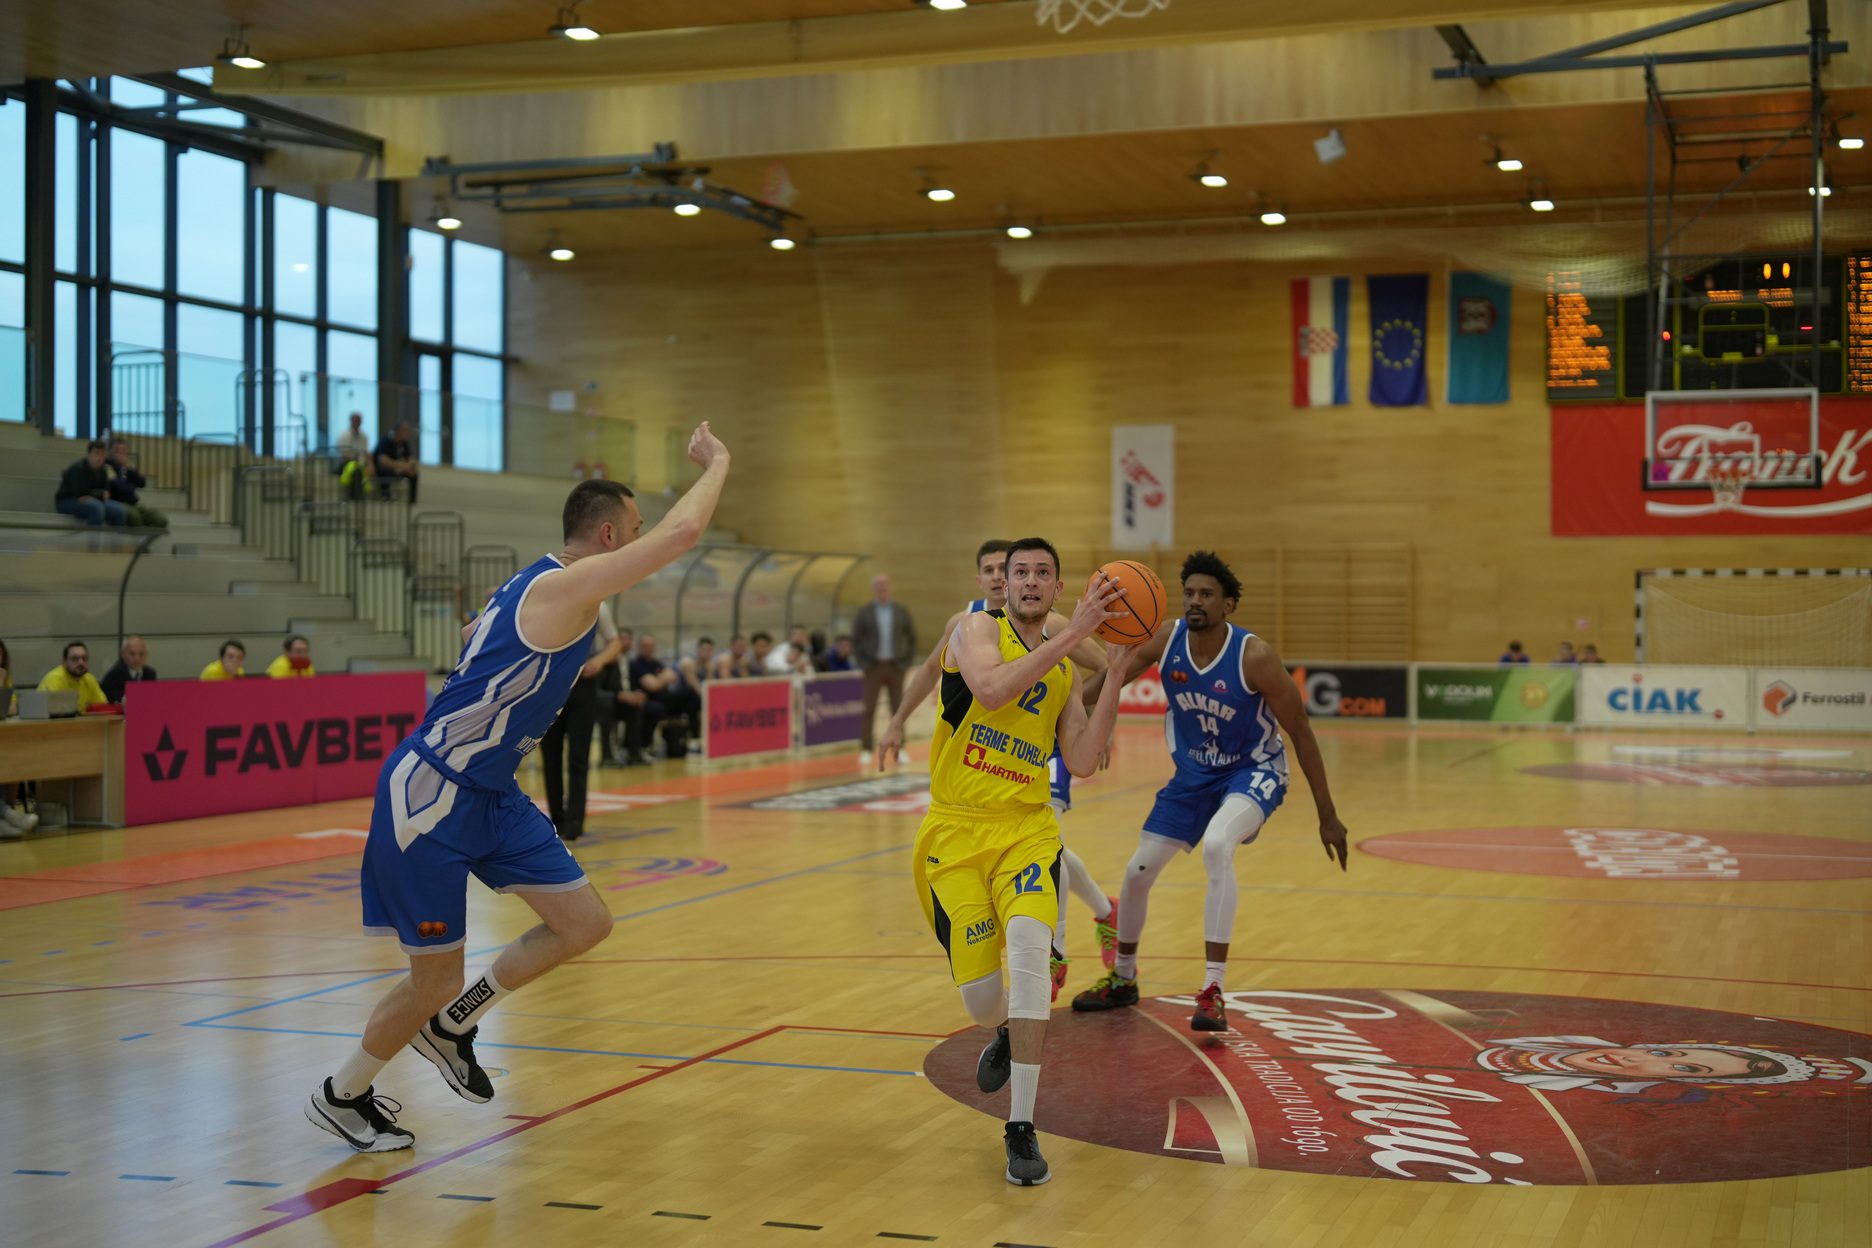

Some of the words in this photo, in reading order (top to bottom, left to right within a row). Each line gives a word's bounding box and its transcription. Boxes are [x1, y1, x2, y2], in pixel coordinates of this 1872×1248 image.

[1016, 681, 1048, 716] 12
[1175, 691, 1237, 722] ALKAR
[1802, 691, 1866, 705] Ferrostil
[970, 723, 1010, 753] TERME
[1197, 714, 1220, 736] 14
[204, 713, 416, 777] FAVBET
[981, 761, 1035, 785] HARTMA
[1249, 771, 1278, 800] 14
[1011, 862, 1043, 896] 12
[966, 918, 995, 940] AMG
[448, 978, 493, 1023] STANCE
[1243, 1060, 1313, 1104] TRADICIJA
[1281, 1107, 1324, 1122] OD
